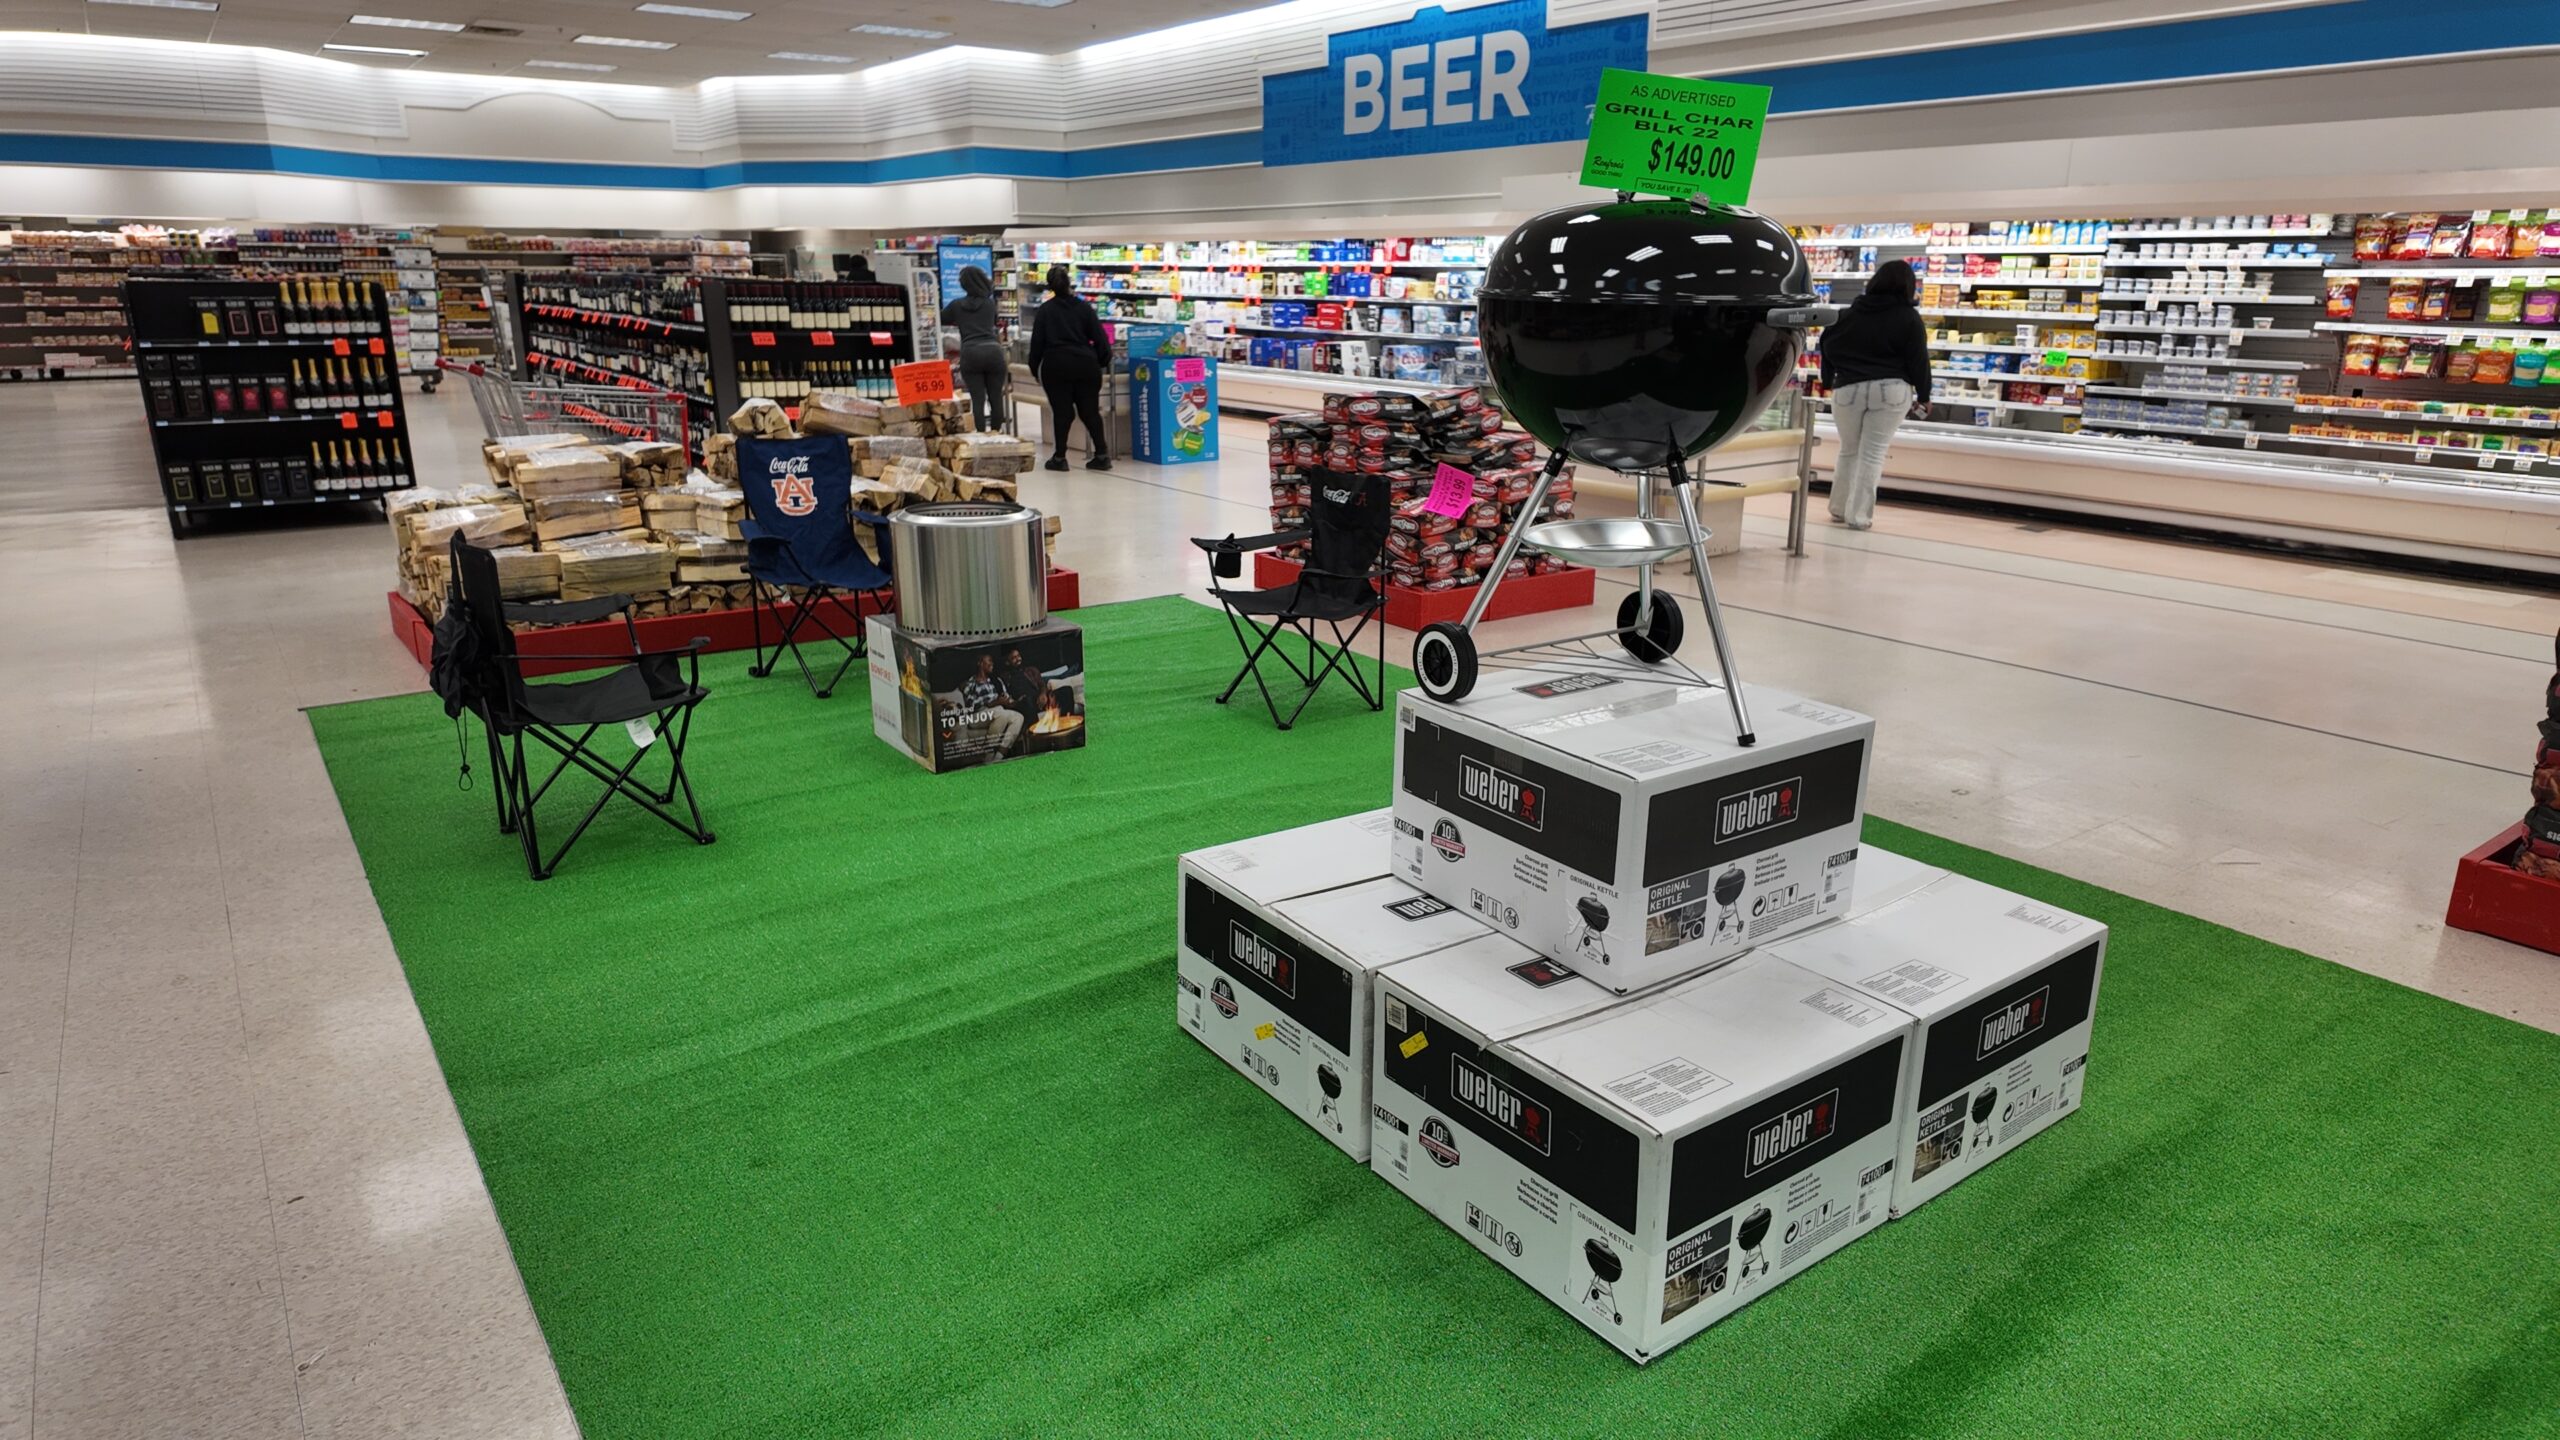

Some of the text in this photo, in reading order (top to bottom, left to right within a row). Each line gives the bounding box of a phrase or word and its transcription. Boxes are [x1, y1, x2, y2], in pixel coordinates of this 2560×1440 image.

[1344, 29, 1531, 136] BEER
[1631, 85, 1736, 108] AS ADVERTISED
[1605, 103, 1677, 121] GRILL
[1685, 113, 1754, 129] CHAR
[1634, 120, 1719, 139] BLK 22
[1648, 137, 1735, 179] $149.00
[1640, 182, 1656, 190] YOU
[1656, 183, 1676, 192] SAVE
[915, 379, 945, 394] $6.99
[1446, 478, 1466, 508] $13.99
[941, 711, 994, 728] TO ENJOY
[1464, 765, 1520, 813] weber
[1722, 790, 1778, 835] weber
[1441, 823, 1452, 839] 10
[1472, 890, 1484, 903] 14
[1570, 874, 1619, 899] ORIGINAL KETTLE
[1650, 879, 1691, 900] ORIGINAL
[1395, 897, 1446, 917] web
[1649, 893, 1683, 912] KETTLE
[1234, 928, 1278, 980] weber
[1219, 982, 1227, 997] 10
[1983, 1002, 2031, 1051] weber
[1458, 1064, 1521, 1129] weber
[1373, 1105, 1400, 1131] 741001
[1921, 1103, 1954, 1127] ORIGINAL
[1431, 1122, 1443, 1142] 10
[1753, 1109, 1813, 1166] weber
[1919, 1117, 1947, 1138] KETTLE
[1468, 1204, 1481, 1220] 14
[1577, 1210, 1634, 1252] ORIGINAL KETTLE
[1669, 1230, 1713, 1261] ORIGINAL
[1667, 1246, 1703, 1274] KETTLE
